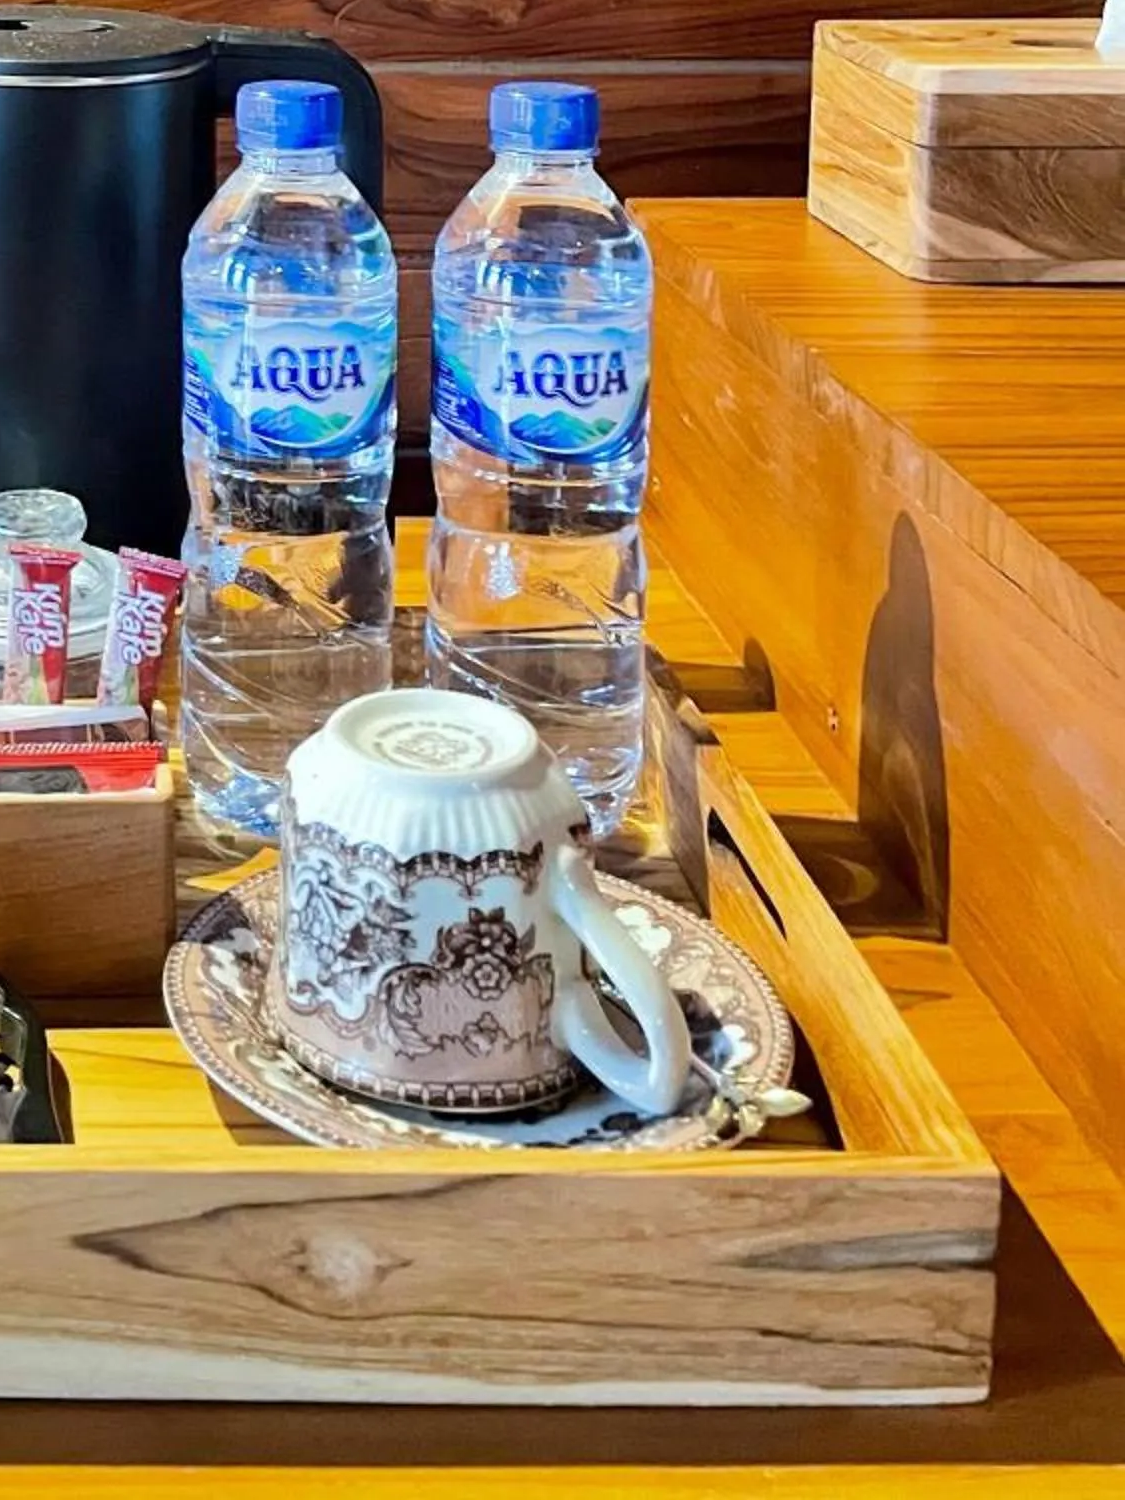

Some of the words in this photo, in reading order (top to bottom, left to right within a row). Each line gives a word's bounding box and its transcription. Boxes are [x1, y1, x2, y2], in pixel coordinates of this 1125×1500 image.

[231, 344, 365, 402] AQUA
[493, 350, 629, 407] AQUA
[13, 587, 45, 655] Kafe
[33, 583, 66, 648] Krim
[116, 592, 146, 665] Kafe
[136, 581, 168, 657] Krim
